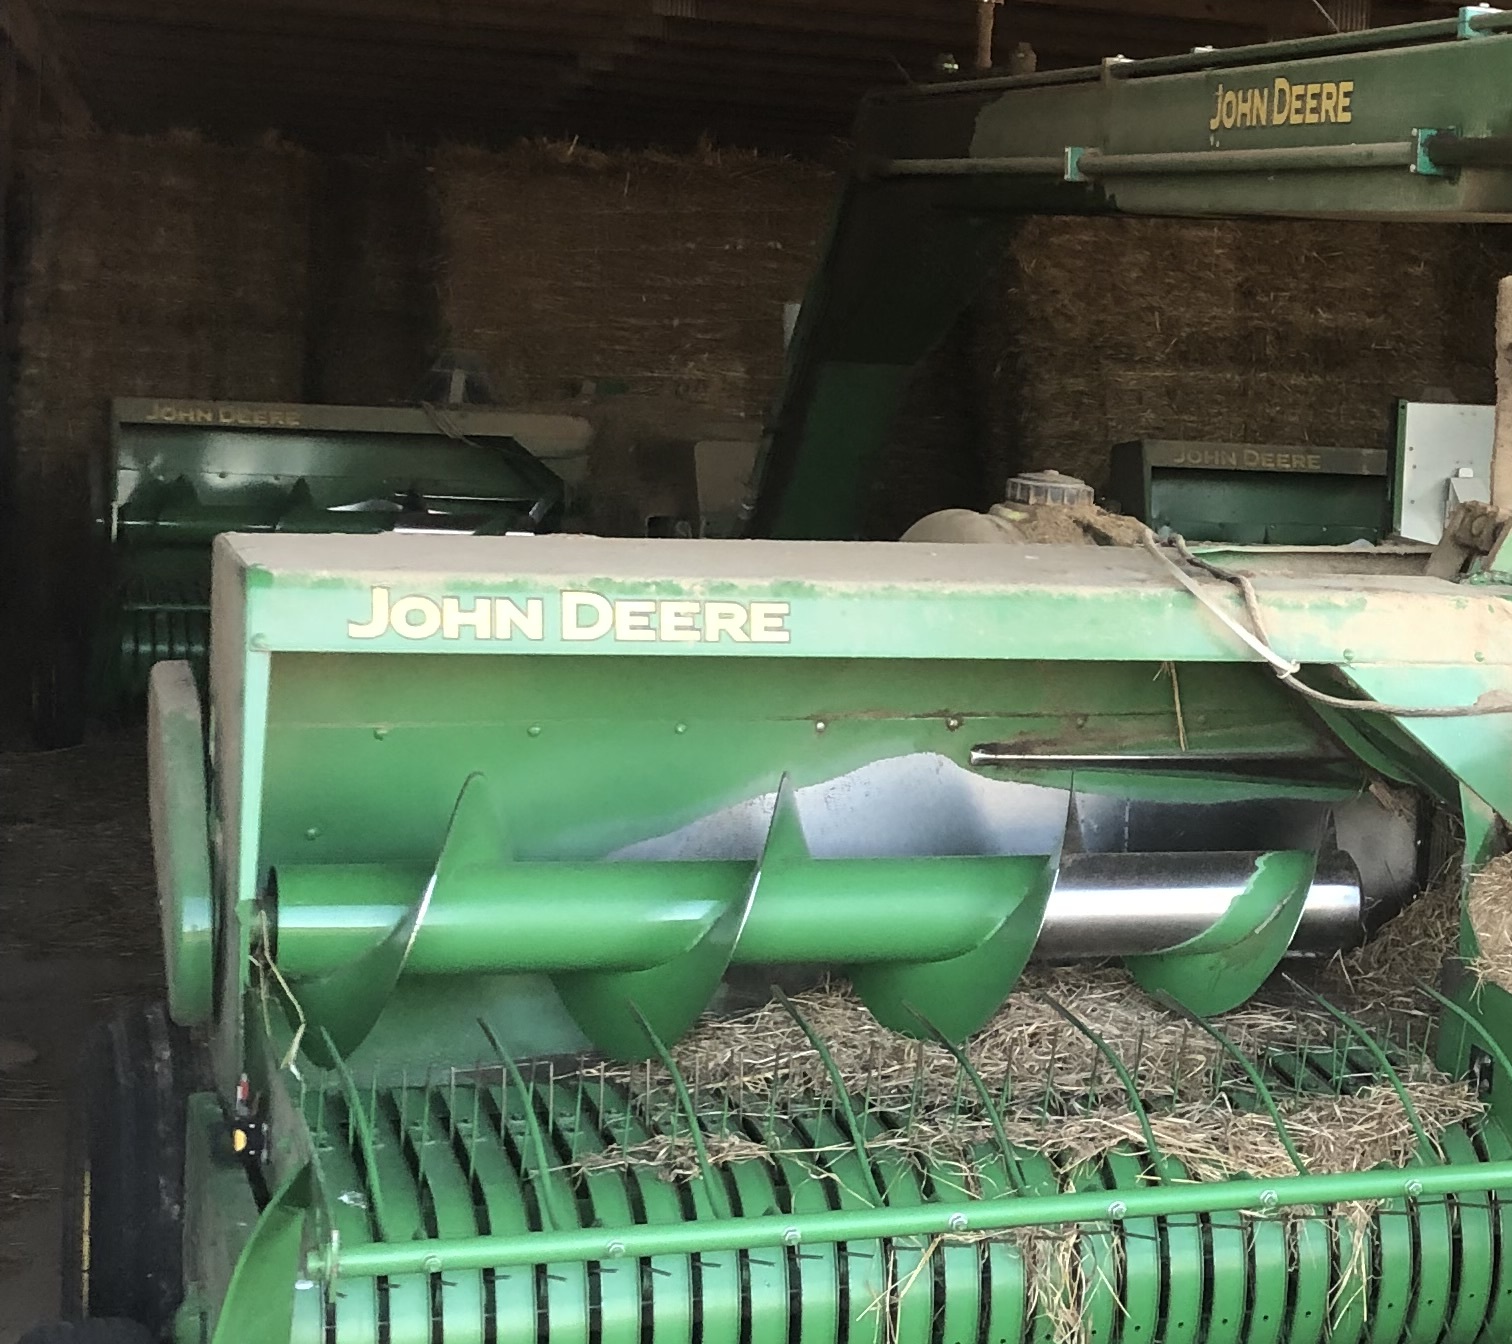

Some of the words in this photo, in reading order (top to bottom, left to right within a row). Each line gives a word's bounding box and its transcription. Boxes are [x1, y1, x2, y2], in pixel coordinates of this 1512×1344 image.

[1210, 83, 1268, 131] JOHN
[1273, 77, 1354, 125] DEERE
[146, 404, 212, 422] JOHN
[1173, 446, 1237, 466] JOHN
[1243, 449, 1321, 470] DEERE
[348, 586, 544, 642] JOHN
[560, 589, 792, 644] DEERE
